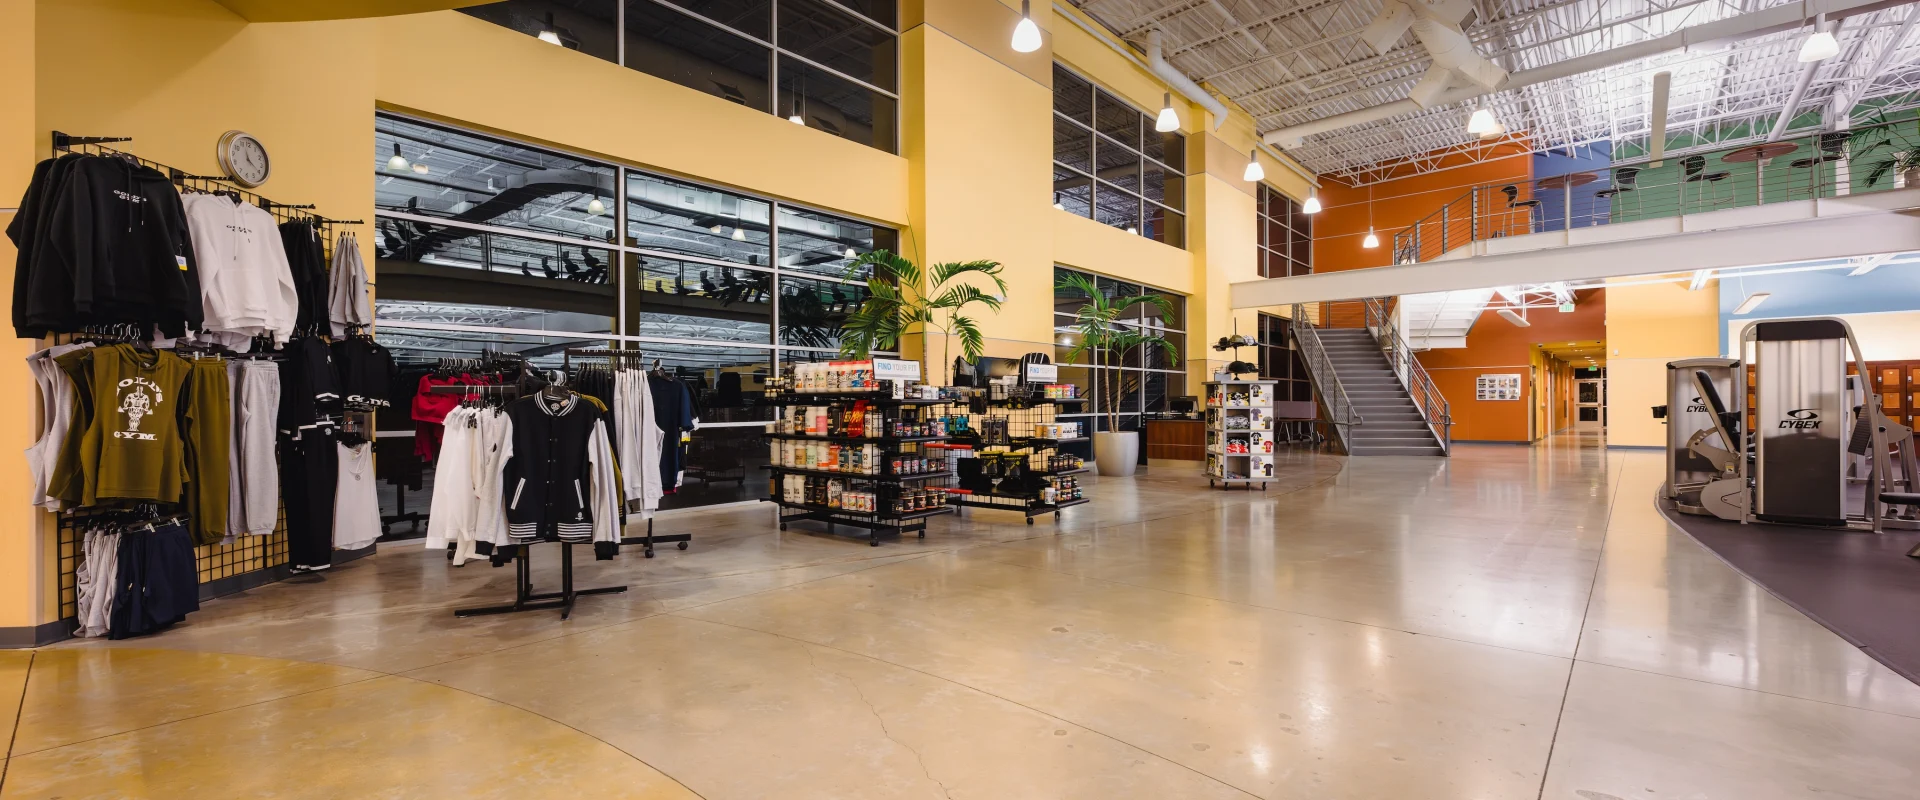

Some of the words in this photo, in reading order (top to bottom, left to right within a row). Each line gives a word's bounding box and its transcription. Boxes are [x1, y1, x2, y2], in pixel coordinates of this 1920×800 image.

[877, 362, 891, 371] FIND
[117, 377, 162, 406] OLD'S
[347, 395, 390, 408] GLD'S
[1778, 420, 1822, 429] CYBEX
